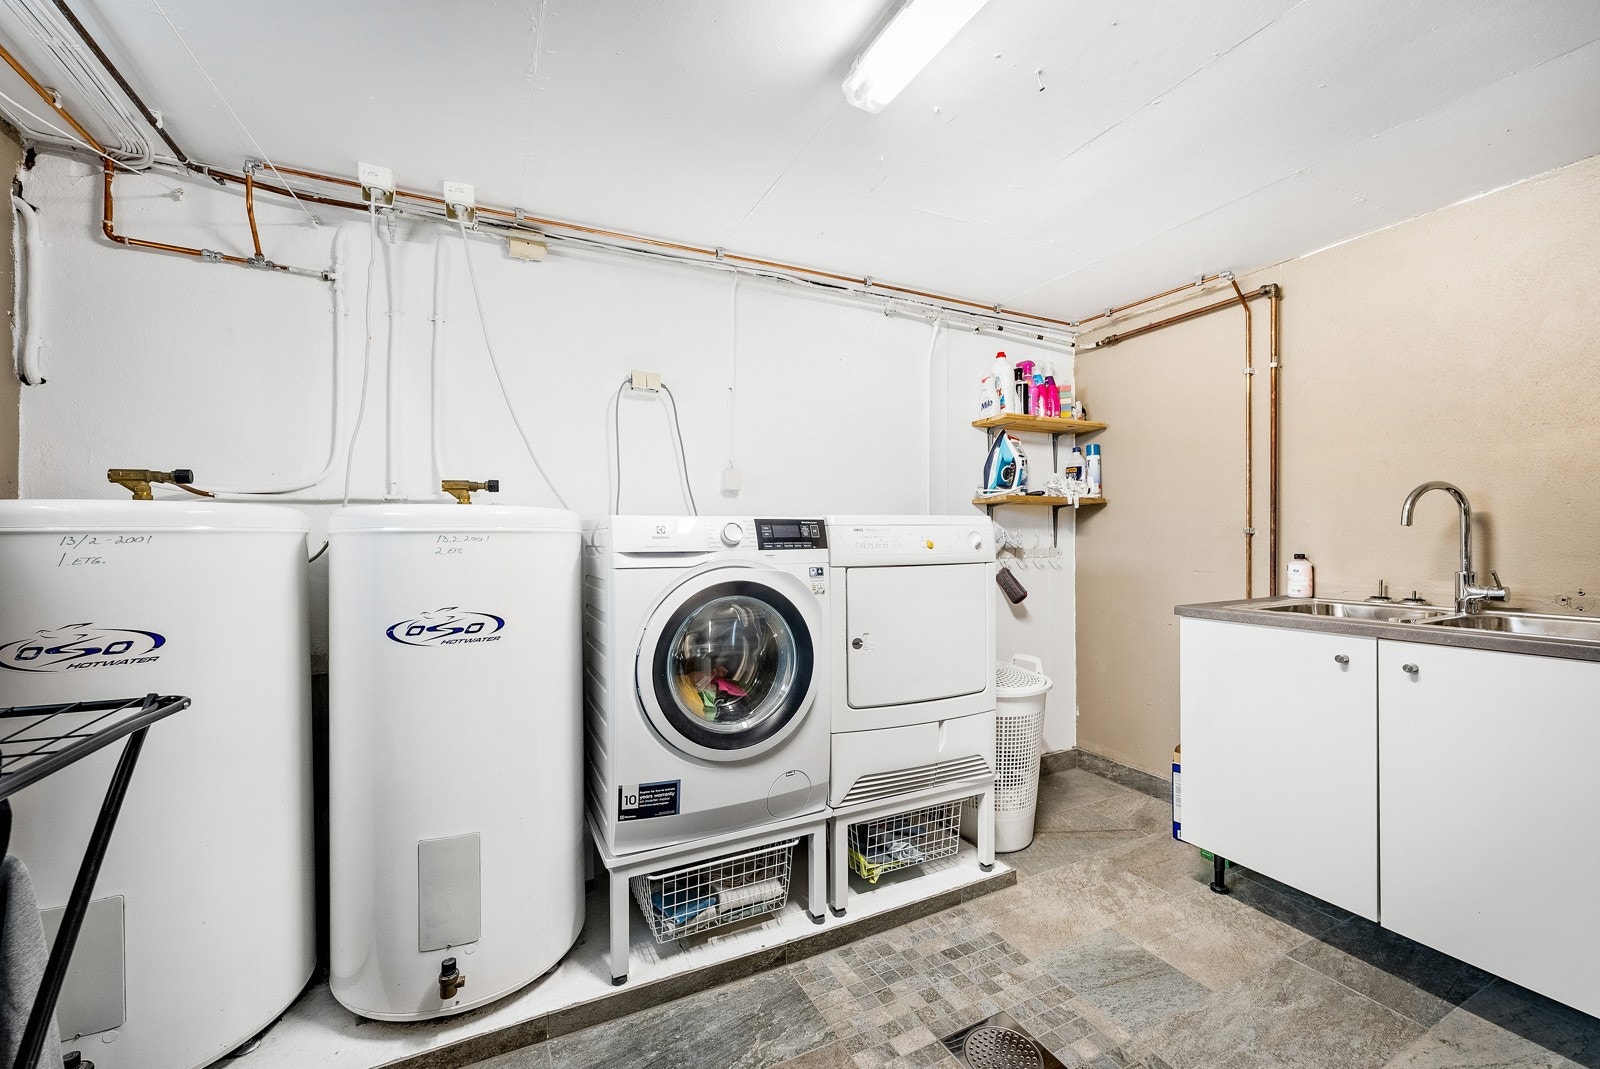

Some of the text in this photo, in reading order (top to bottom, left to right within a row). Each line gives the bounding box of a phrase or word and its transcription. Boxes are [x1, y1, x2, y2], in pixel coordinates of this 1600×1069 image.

[440, 635, 502, 645] HOTWATER
[65, 655, 160, 670] HOTWATER
[624, 795, 637, 806] 10
